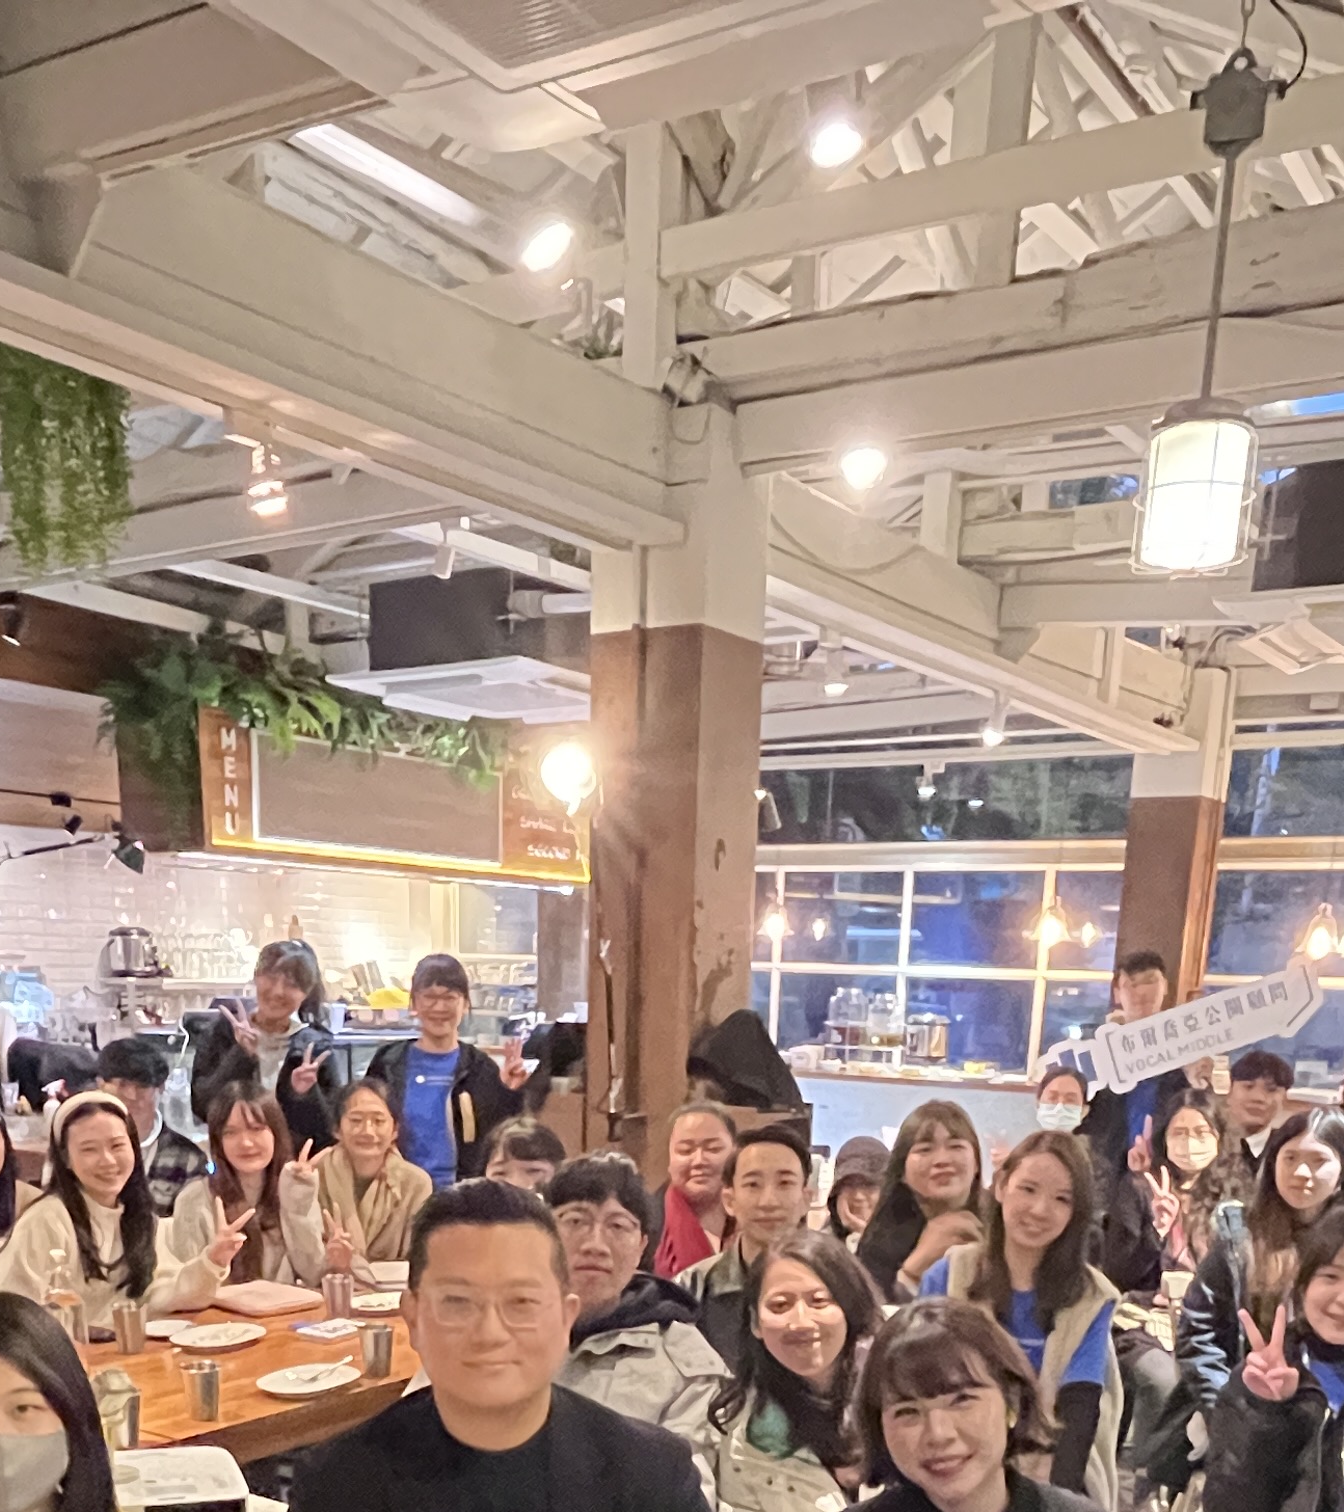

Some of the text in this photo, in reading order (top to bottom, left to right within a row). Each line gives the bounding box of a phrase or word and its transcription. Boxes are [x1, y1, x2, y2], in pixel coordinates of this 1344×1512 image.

[220, 726, 241, 836] MENU
[1125, 1028, 1234, 1076] VOCAL MIDDLE
